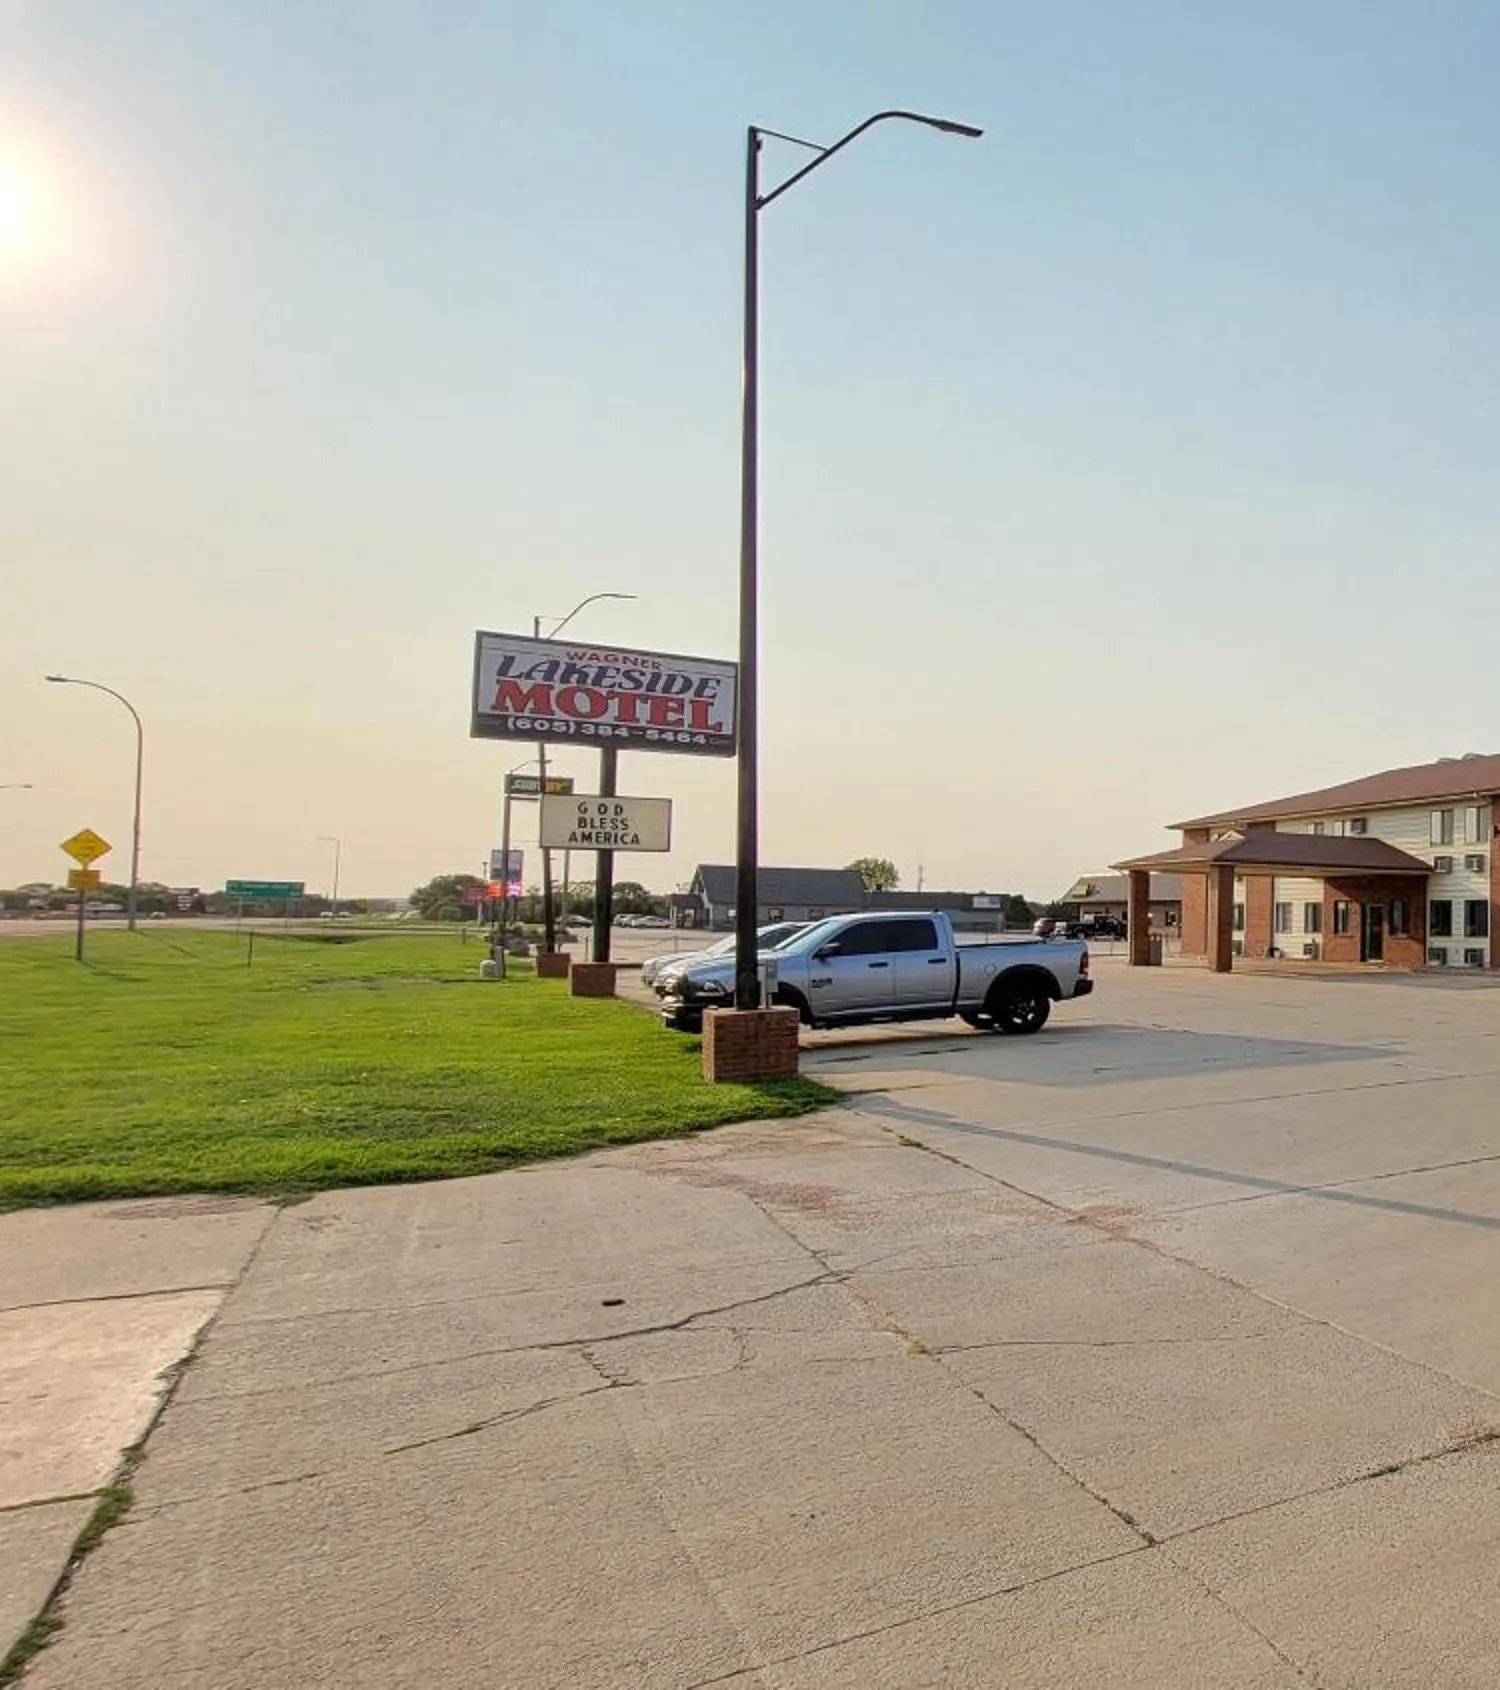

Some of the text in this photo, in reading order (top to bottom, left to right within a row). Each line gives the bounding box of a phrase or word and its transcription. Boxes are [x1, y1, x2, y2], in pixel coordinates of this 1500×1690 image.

[566, 651, 662, 671] WAGNER
[496, 655, 721, 699] LAKESIDE
[491, 679, 722, 733] MOTEL
[507, 717, 576, 735] (605)
[577, 802, 624, 815] GOD
[577, 817, 630, 831] BLESS
[568, 831, 640, 845] AMERICA
